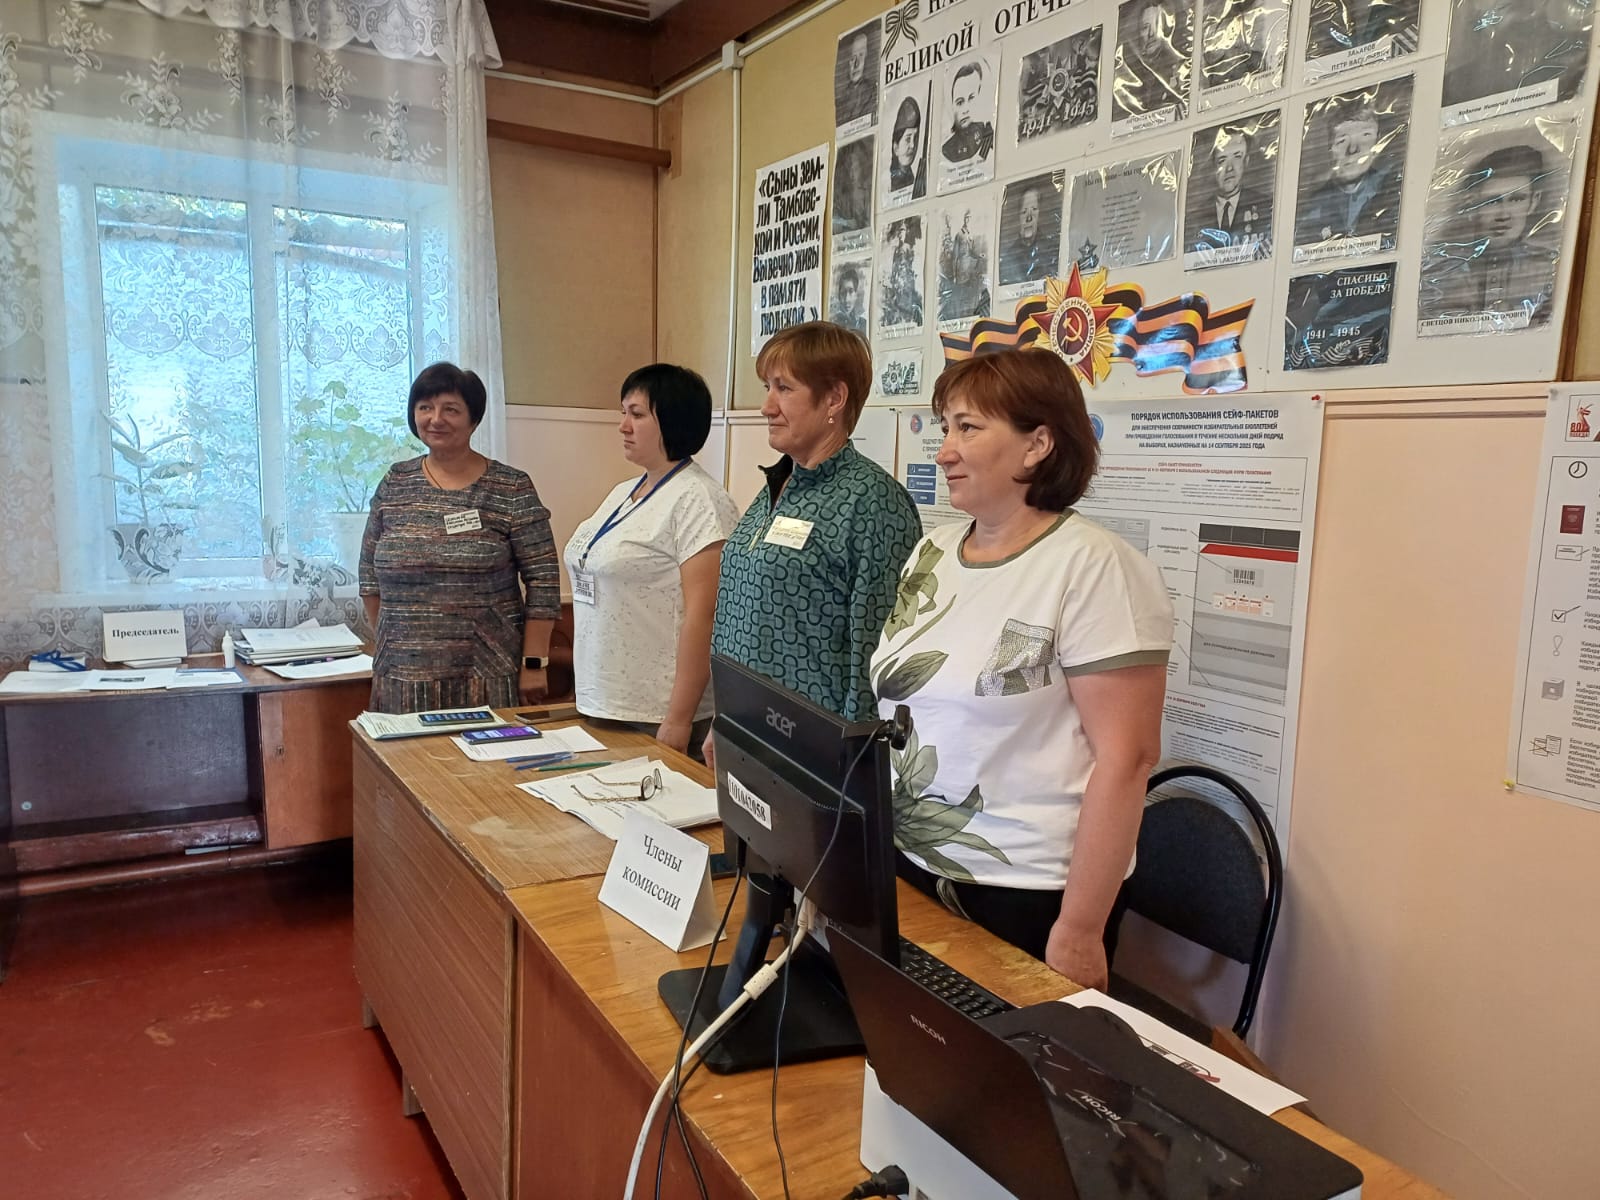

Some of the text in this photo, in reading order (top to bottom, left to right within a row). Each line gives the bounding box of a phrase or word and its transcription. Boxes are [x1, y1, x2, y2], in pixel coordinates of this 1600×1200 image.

[885, 20, 974, 85] ВЕЛИКОЙ
[1063, 101, 1095, 122] 1945
[758, 156, 825, 198] «Сыны зем-
[756, 187, 821, 228] ли Тамбовс-
[754, 228, 772, 256] кой
[783, 215, 820, 246] России,
[768, 251, 794, 280] вечно
[794, 245, 820, 273] живы
[768, 278, 806, 305] памяти
[1330, 283, 1391, 299] ЗА ПОБЕДУ!
[1336, 272, 1388, 286] СПАСИБО
[1306, 329, 1326, 339] 1941
[1337, 326, 1361, 338] 1945
[1131, 409, 1279, 421] ПОРЯДОК ИСПОЛЬЗОВАНИЯ СЕЙФ-ПАКЕТОВ
[112, 628, 180, 639] Председатель
[766, 706, 797, 739] acer
[643, 834, 684, 873] Члены
[621, 865, 682, 911] комиссии
[910, 1014, 947, 1046] RICOH
[1080, 1095, 1122, 1121] RICOH
